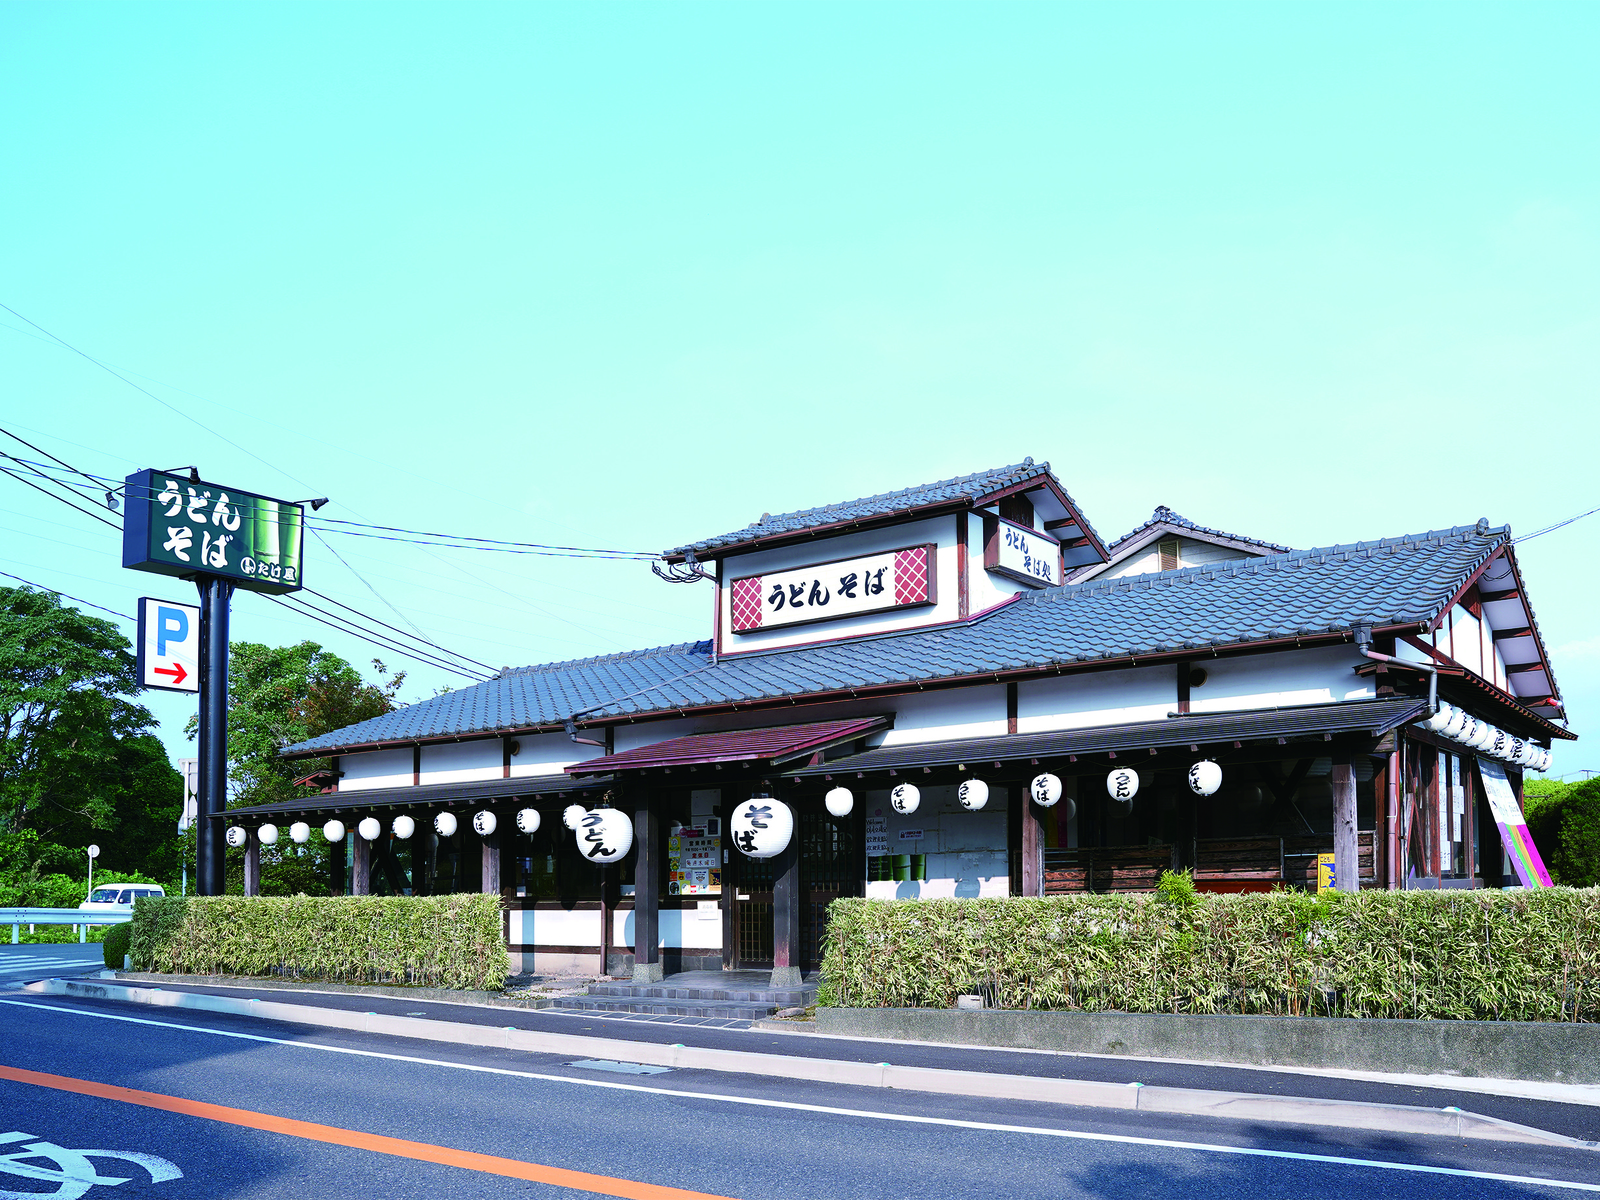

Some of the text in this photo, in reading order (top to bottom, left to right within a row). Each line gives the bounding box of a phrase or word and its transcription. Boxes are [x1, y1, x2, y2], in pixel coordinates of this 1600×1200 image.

[157, 480, 241, 532] うどん
[163, 526, 234, 568] そば
[1005, 527, 1029, 554] うどん
[768, 566, 888, 612] うどん そば
[1023, 555, 1052, 582] そば処
[157, 605, 189, 657] P
[893, 787, 905, 811] そば
[1036, 776, 1049, 802] そば
[1116, 772, 1130, 798] うどん
[581, 814, 616, 857] うどん
[735, 804, 773, 853] そば
